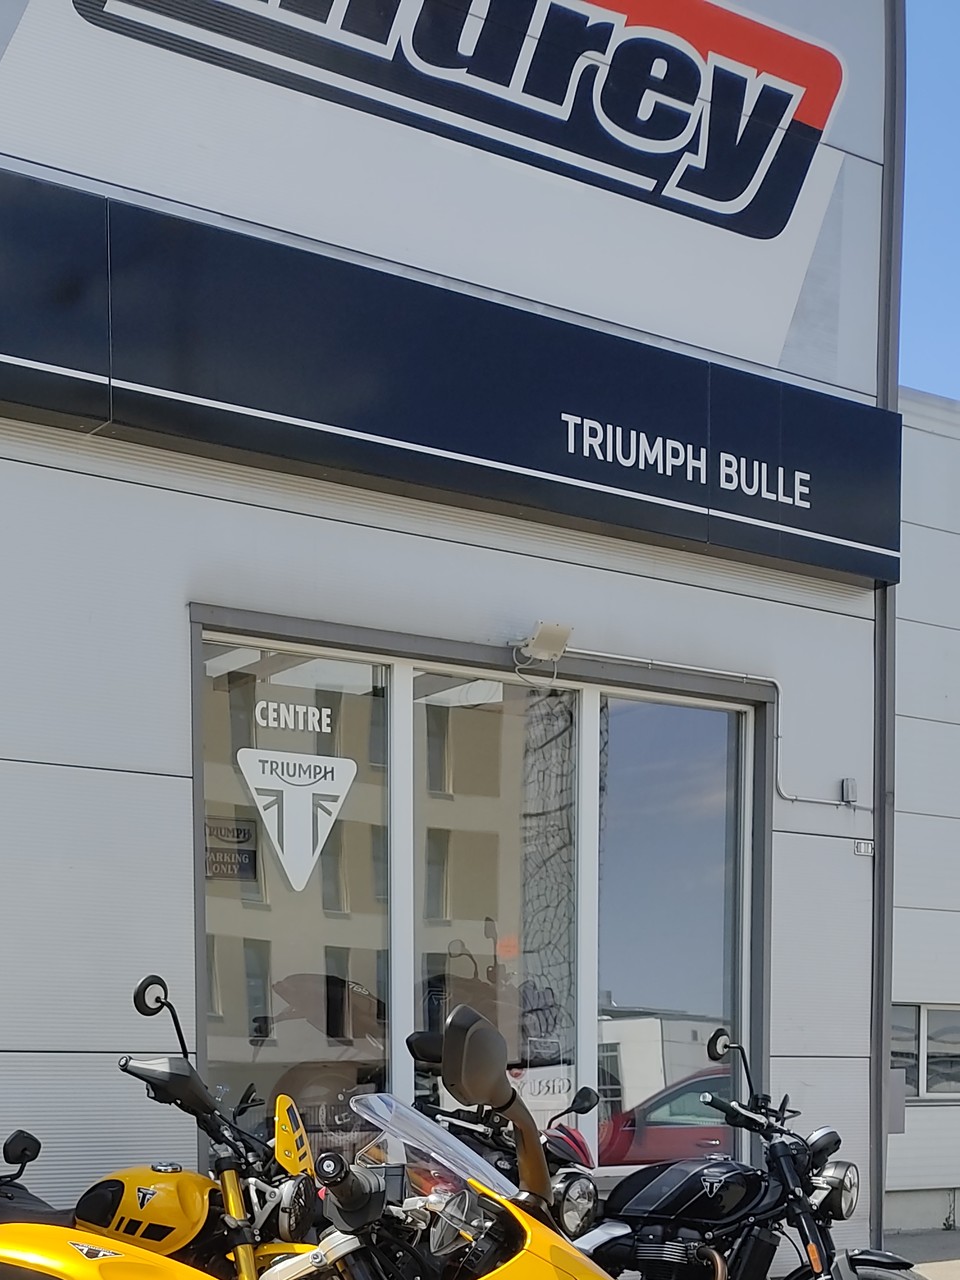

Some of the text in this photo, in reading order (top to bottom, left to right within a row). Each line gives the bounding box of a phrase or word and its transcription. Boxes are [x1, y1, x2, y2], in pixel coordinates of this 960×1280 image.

[560, 412, 812, 509] TRIUMPH BULLE
[255, 700, 332, 733] CENTRE
[258, 759, 335, 785] TRIUMPH
[207, 852, 250, 864] ARKING
[212, 864, 240, 875] ONLY
